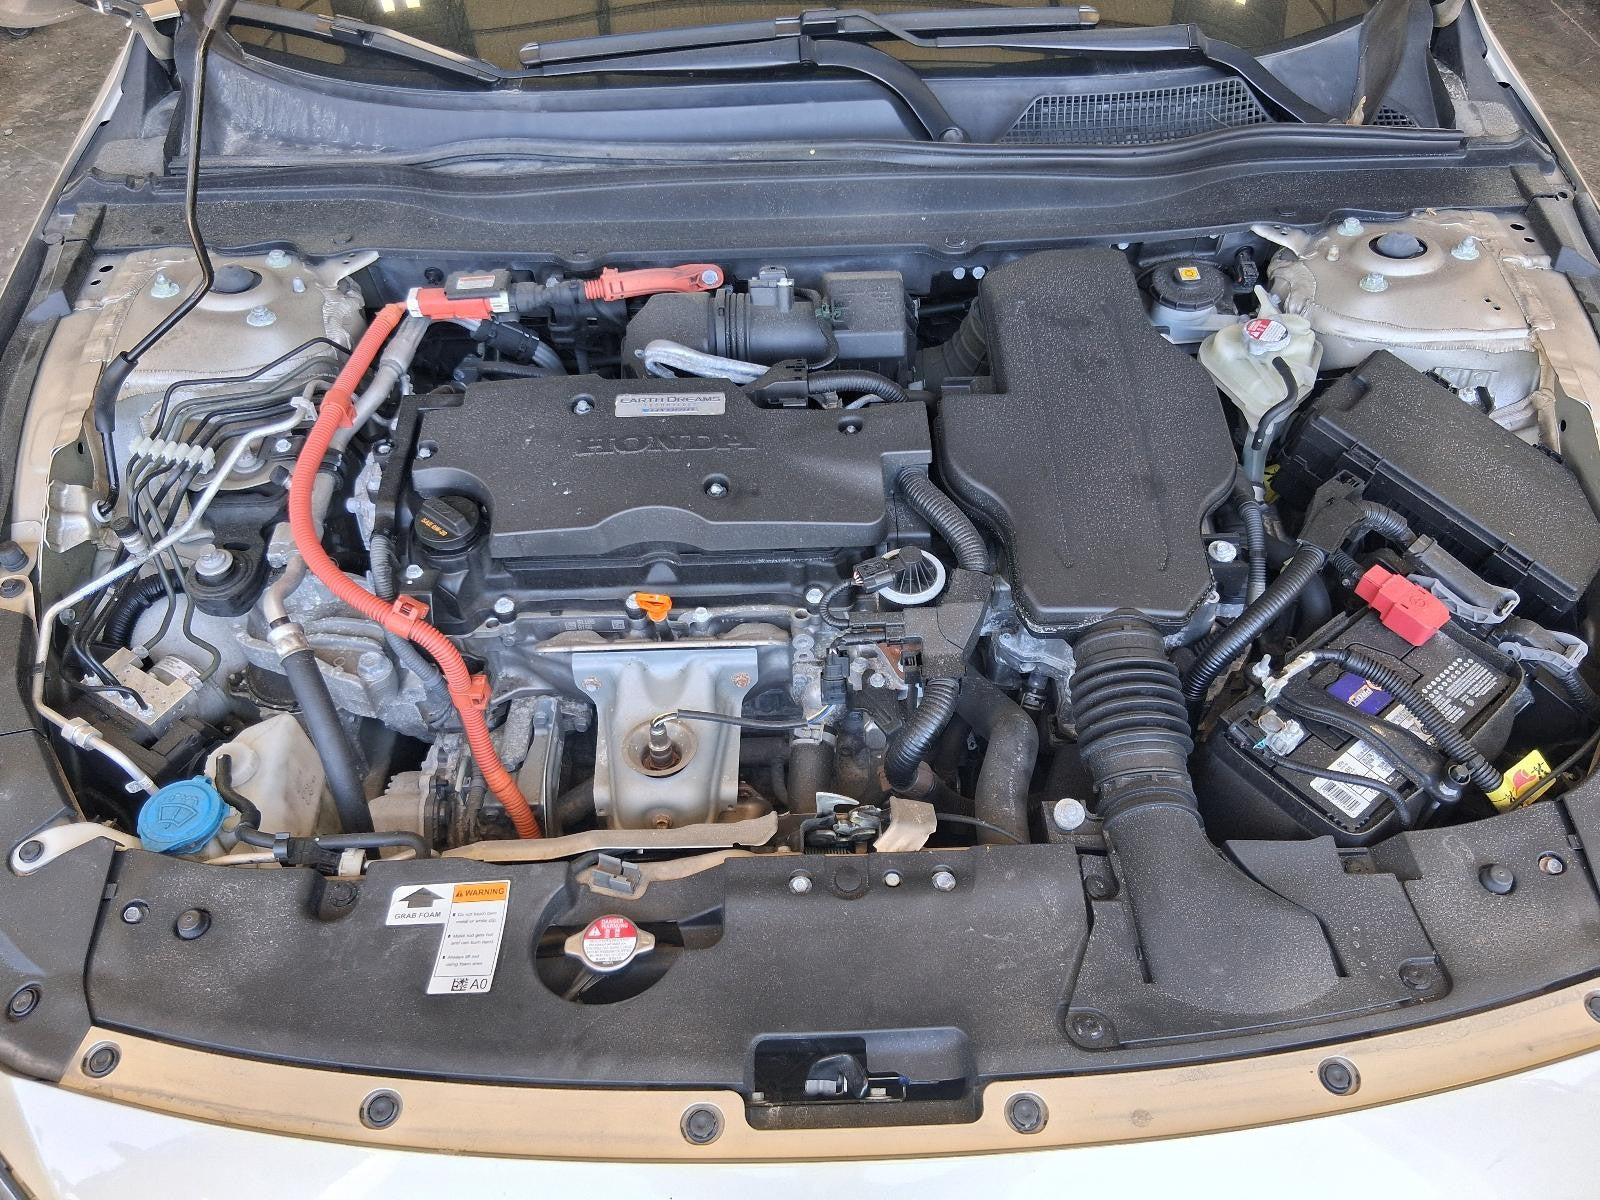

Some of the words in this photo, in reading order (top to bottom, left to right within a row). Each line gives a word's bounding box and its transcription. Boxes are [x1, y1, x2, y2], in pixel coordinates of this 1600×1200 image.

[620, 396, 664, 404] EARTH
[573, 435, 756, 457] HONDA
[465, 888, 505, 897] WARNING
[394, 912, 417, 920] GRAB
[469, 978, 488, 990] A0
